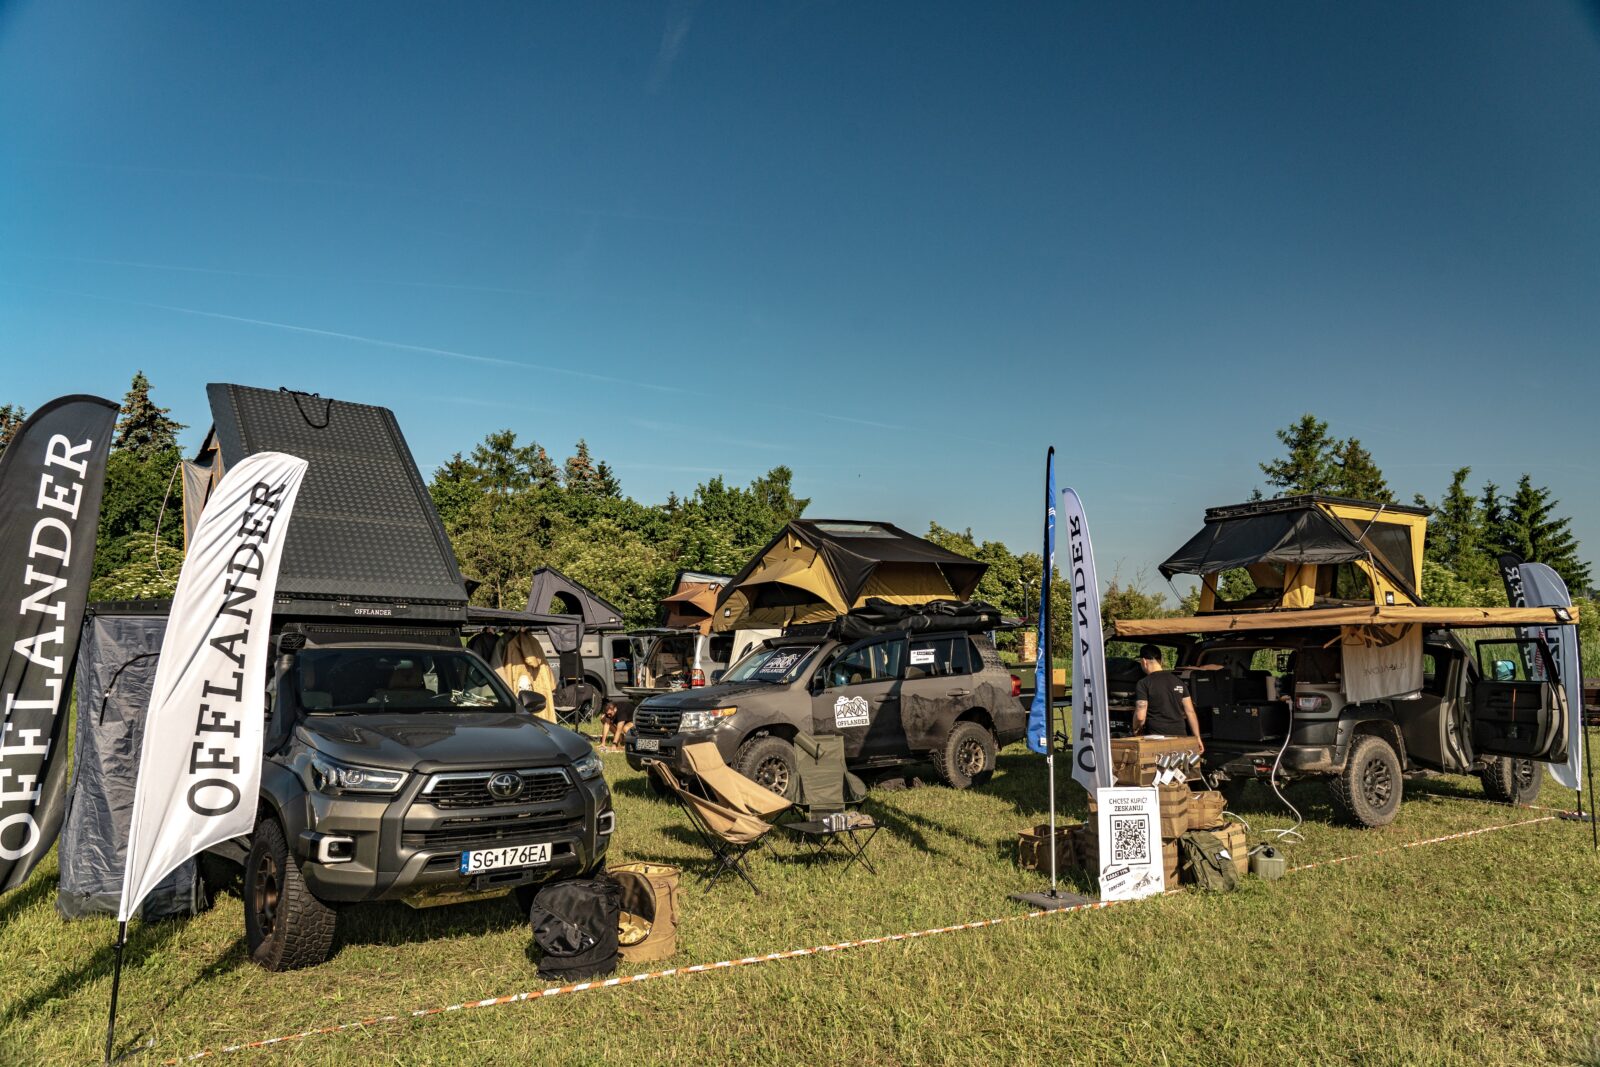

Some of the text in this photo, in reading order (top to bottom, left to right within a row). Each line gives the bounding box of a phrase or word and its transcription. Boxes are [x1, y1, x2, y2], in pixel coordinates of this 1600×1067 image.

[354, 608, 392, 616] OFFLANDER
[0, 433, 93, 861] OFFLANDER
[186, 480, 287, 817] OFFLANDER
[837, 718, 869, 727] OFFLANDER
[1108, 797, 1129, 805] CHCESZ
[473, 845, 547, 868] SG 176EA
